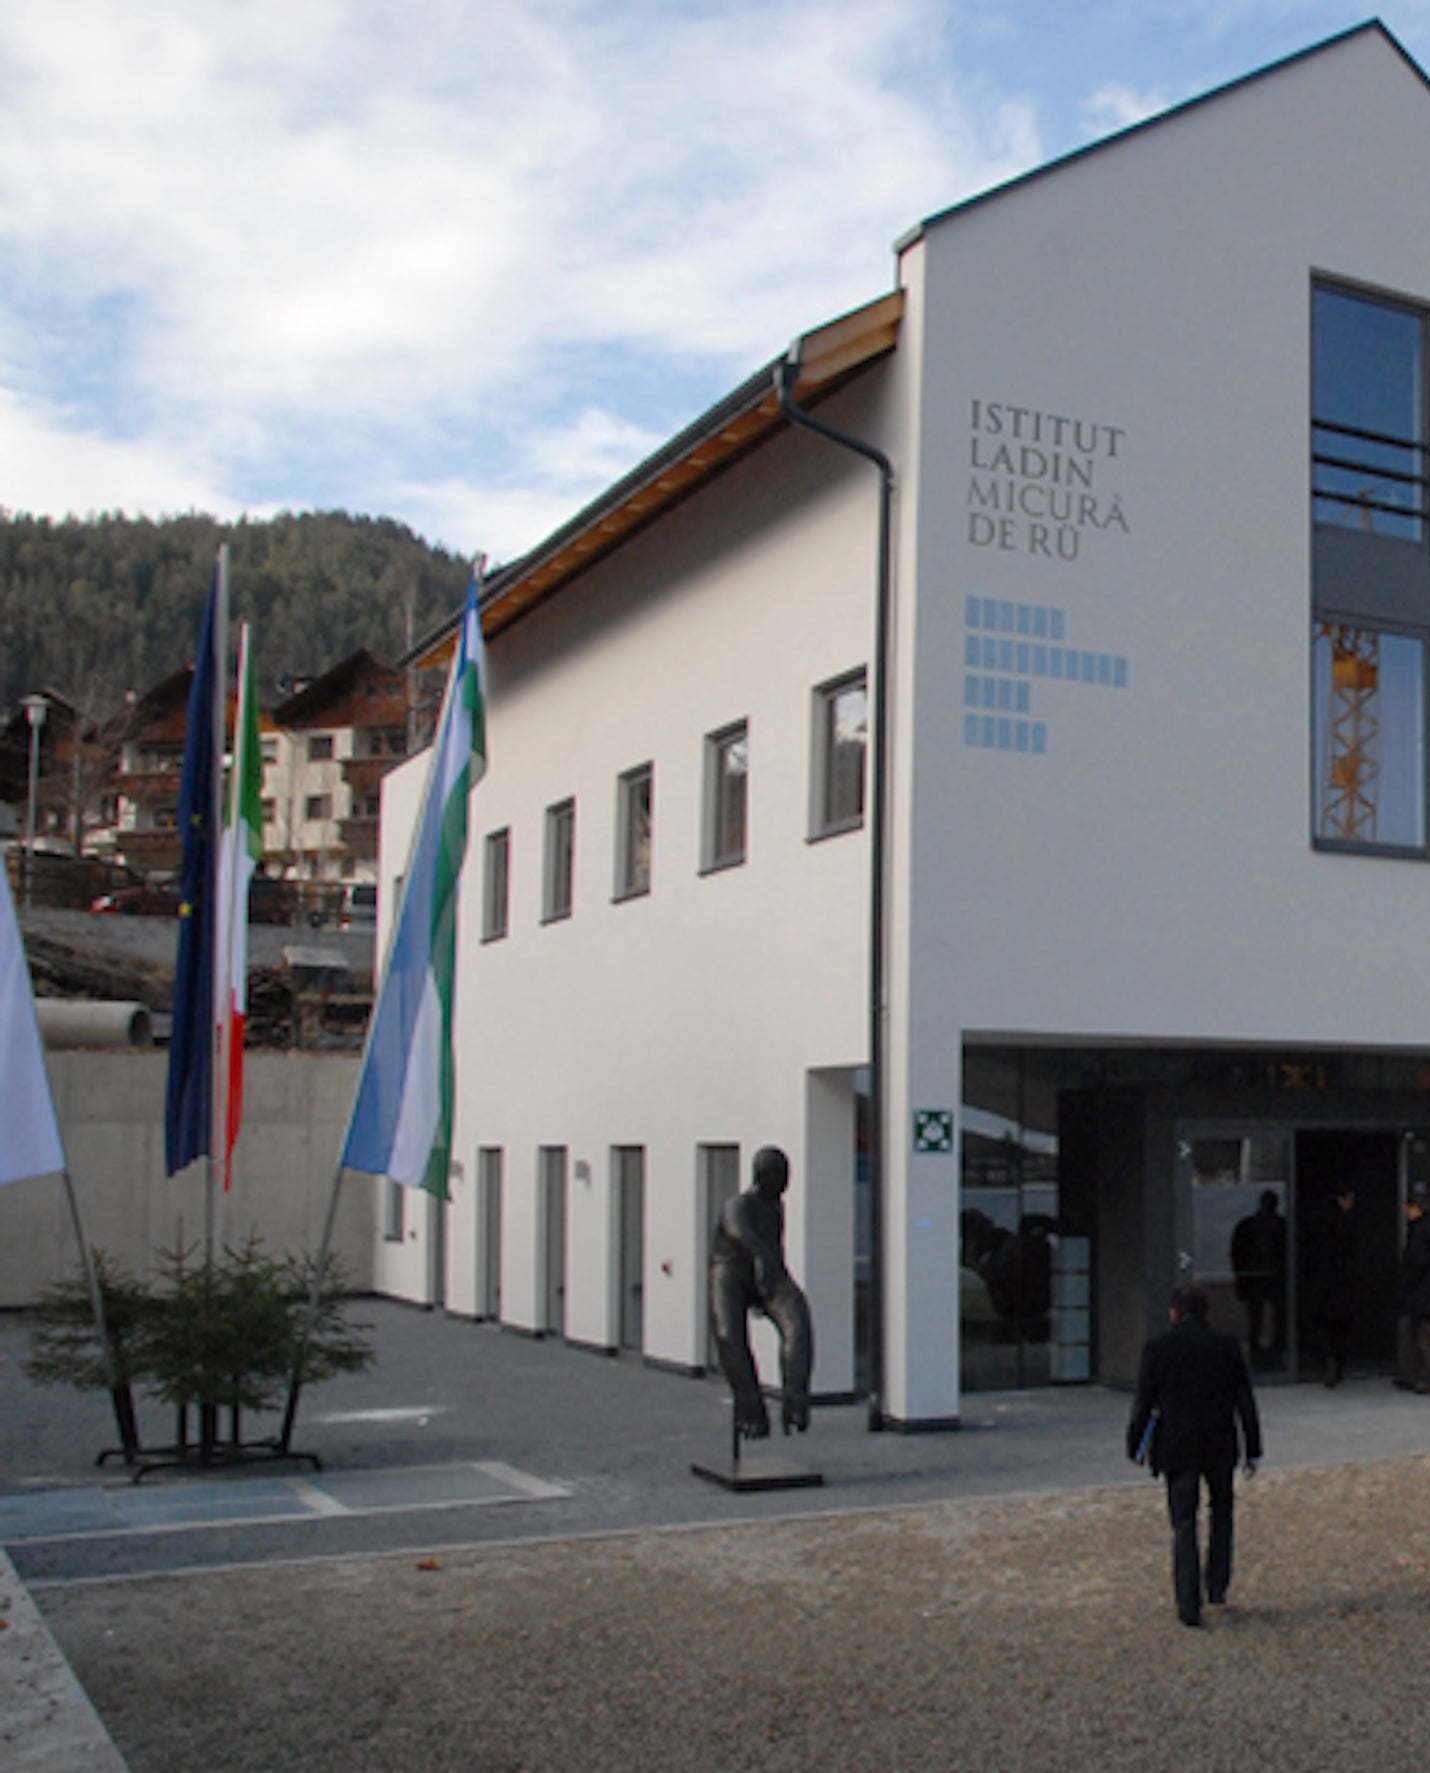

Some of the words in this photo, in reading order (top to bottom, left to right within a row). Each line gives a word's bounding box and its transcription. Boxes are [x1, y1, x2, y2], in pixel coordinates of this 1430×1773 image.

[971, 399, 1125, 458] ISTITUT
[971, 437, 1093, 487] LADIN
[968, 476, 1130, 534] MICURÀ
[968, 512, 1016, 551] DE
